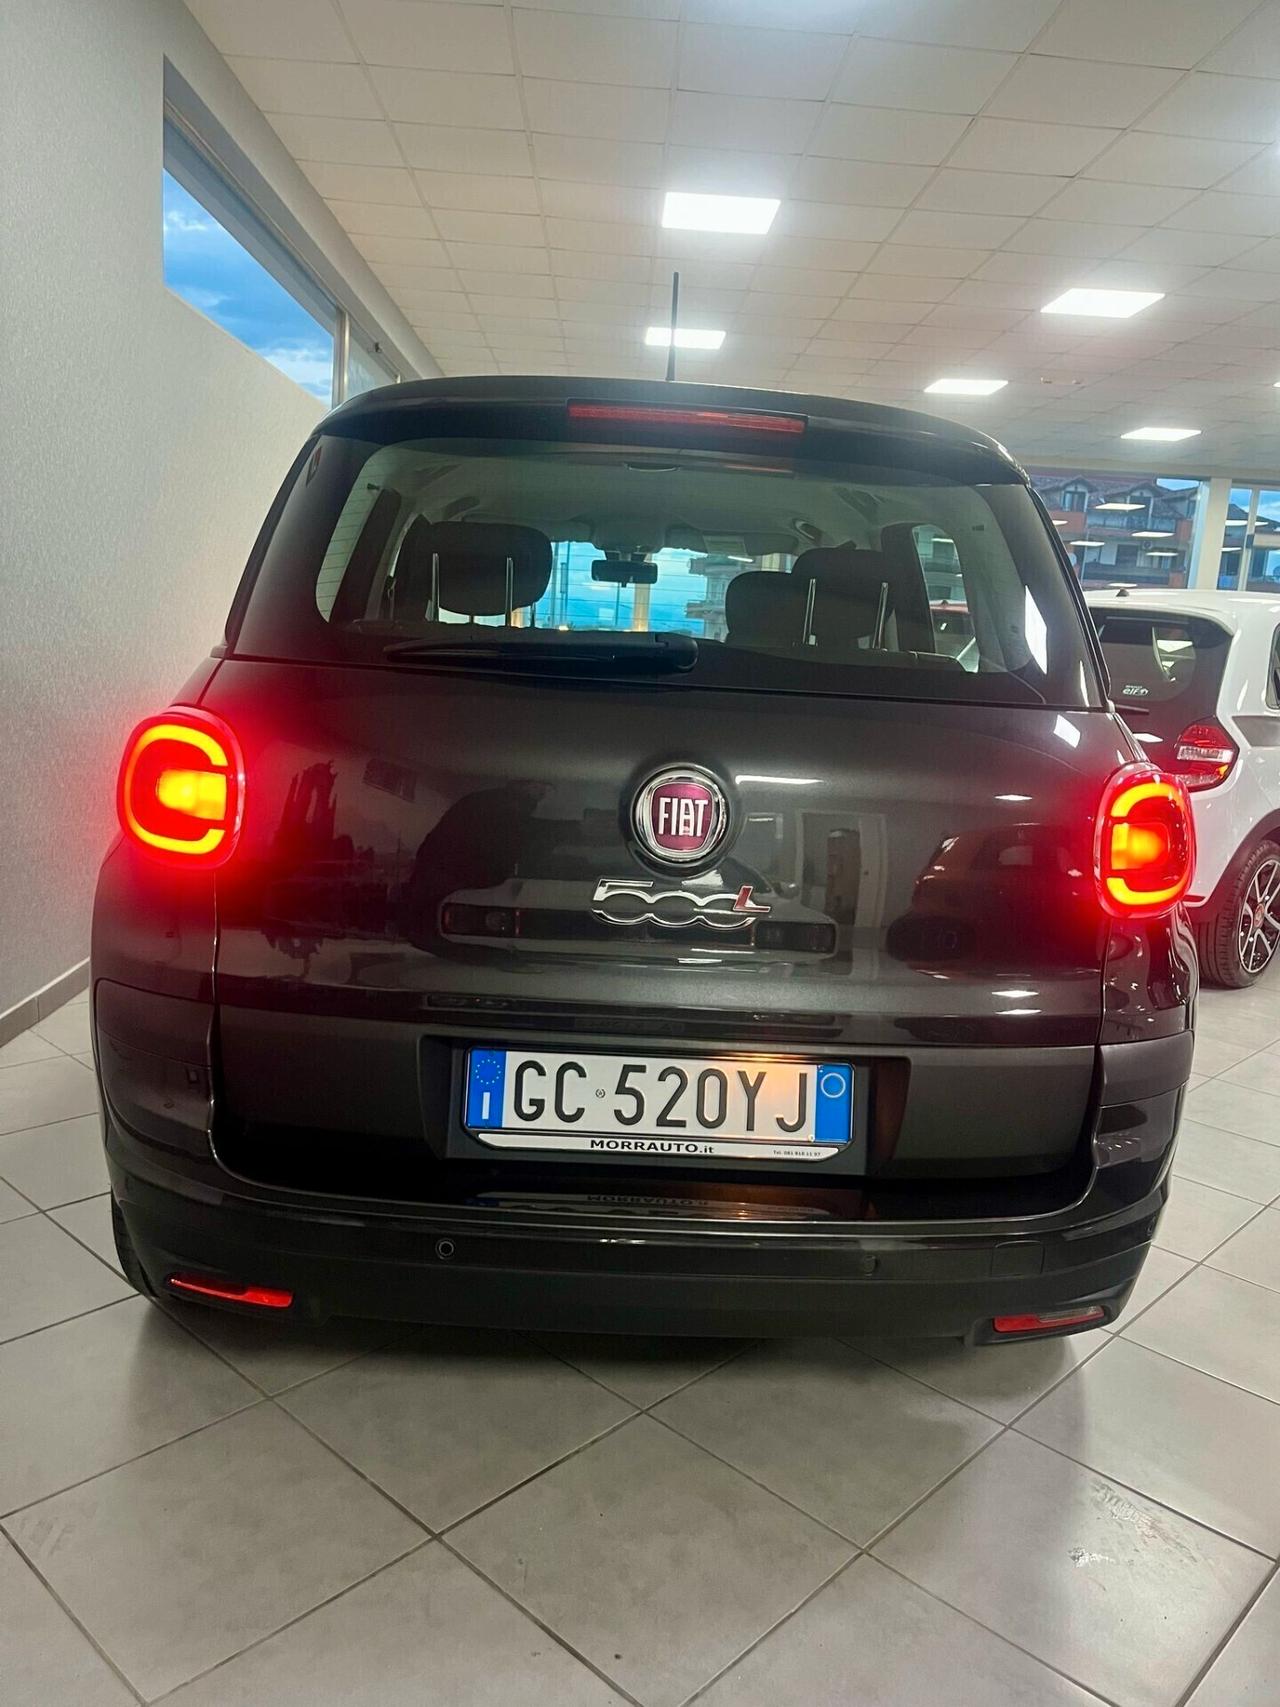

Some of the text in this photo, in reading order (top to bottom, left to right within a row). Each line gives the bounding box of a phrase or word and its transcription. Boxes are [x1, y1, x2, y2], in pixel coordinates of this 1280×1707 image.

[658, 797, 709, 837] FIAT
[514, 1060, 807, 1133] GC 520YJ
[590, 1140, 714, 1154] MORRAUTO.it
